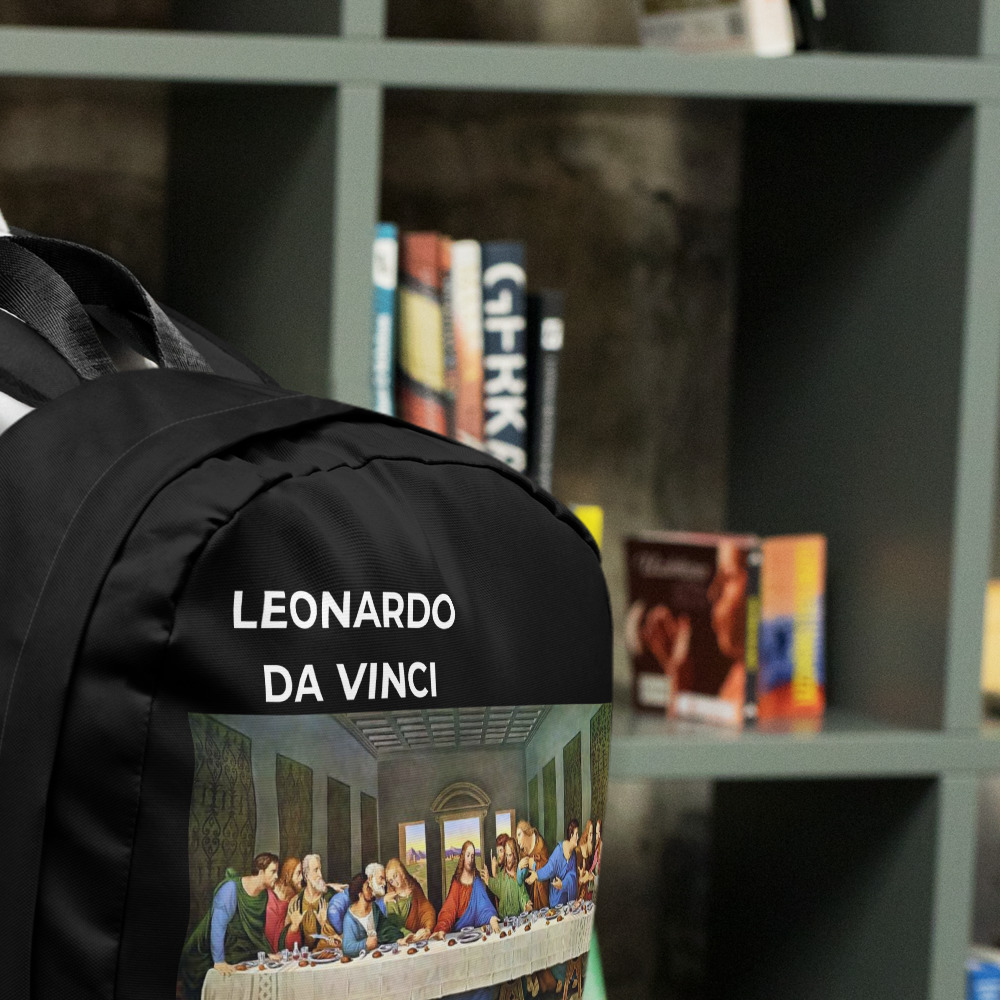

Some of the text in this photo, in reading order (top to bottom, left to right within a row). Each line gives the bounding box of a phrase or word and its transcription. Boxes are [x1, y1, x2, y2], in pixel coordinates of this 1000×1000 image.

[232, 590, 456, 630] LEONARDO
[263, 661, 438, 702] DA VINCI
